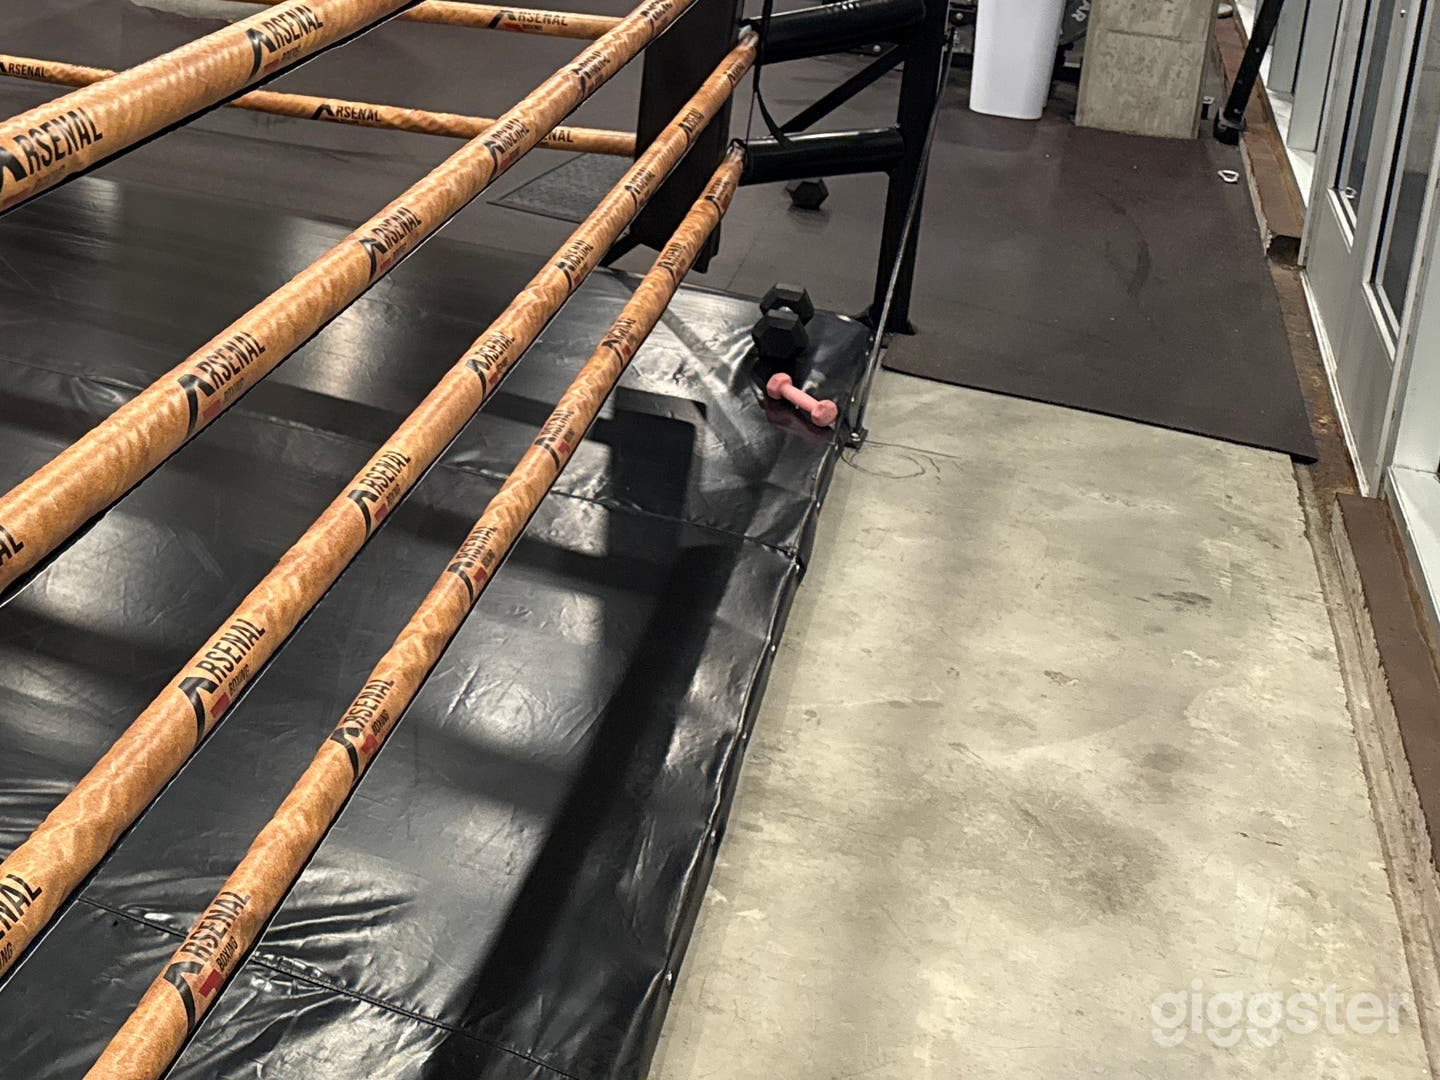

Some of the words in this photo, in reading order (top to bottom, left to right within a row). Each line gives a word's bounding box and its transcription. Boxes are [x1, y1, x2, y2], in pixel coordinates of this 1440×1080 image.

[244, 4, 324, 81] ARSENAL
[312, 103, 381, 121] ARSENAL
[177, 330, 266, 436] ARSENAL
[347, 450, 411, 539] ARSENAL
[178, 617, 265, 750] ARSENAL
[330, 677, 395, 779] ARSENAL
[164, 889, 251, 1028] ARSENAL
[216, 936, 238, 973] BOXING
